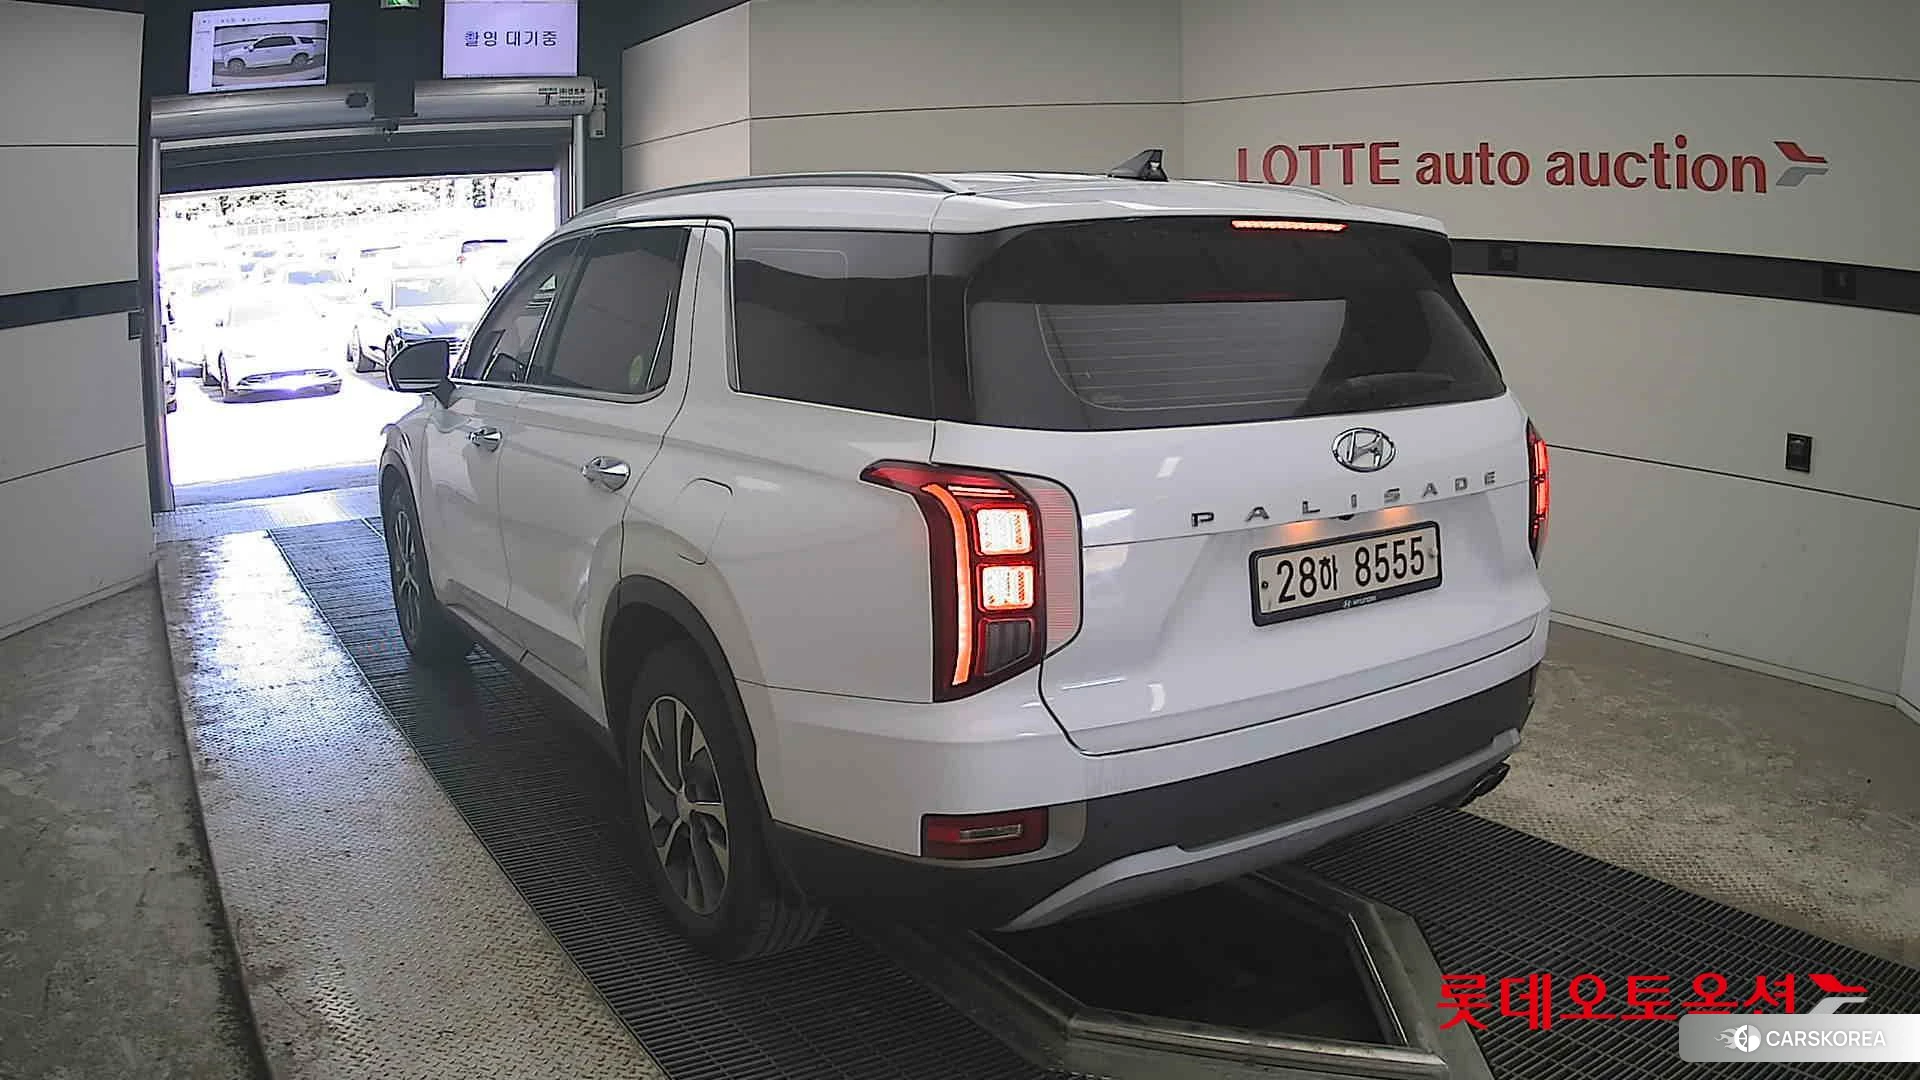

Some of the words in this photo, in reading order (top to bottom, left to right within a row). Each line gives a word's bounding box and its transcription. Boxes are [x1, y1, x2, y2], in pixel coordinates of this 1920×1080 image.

[506, 30, 557, 47] 대기중
[1237, 142, 1400, 186] LOTTE
[1416, 141, 1530, 186] auto
[1546, 134, 1767, 194] auction
[1191, 471, 1496, 528] PALISADE
[1276, 554, 1338, 604] 28하
[1354, 535, 1425, 588] 8555
